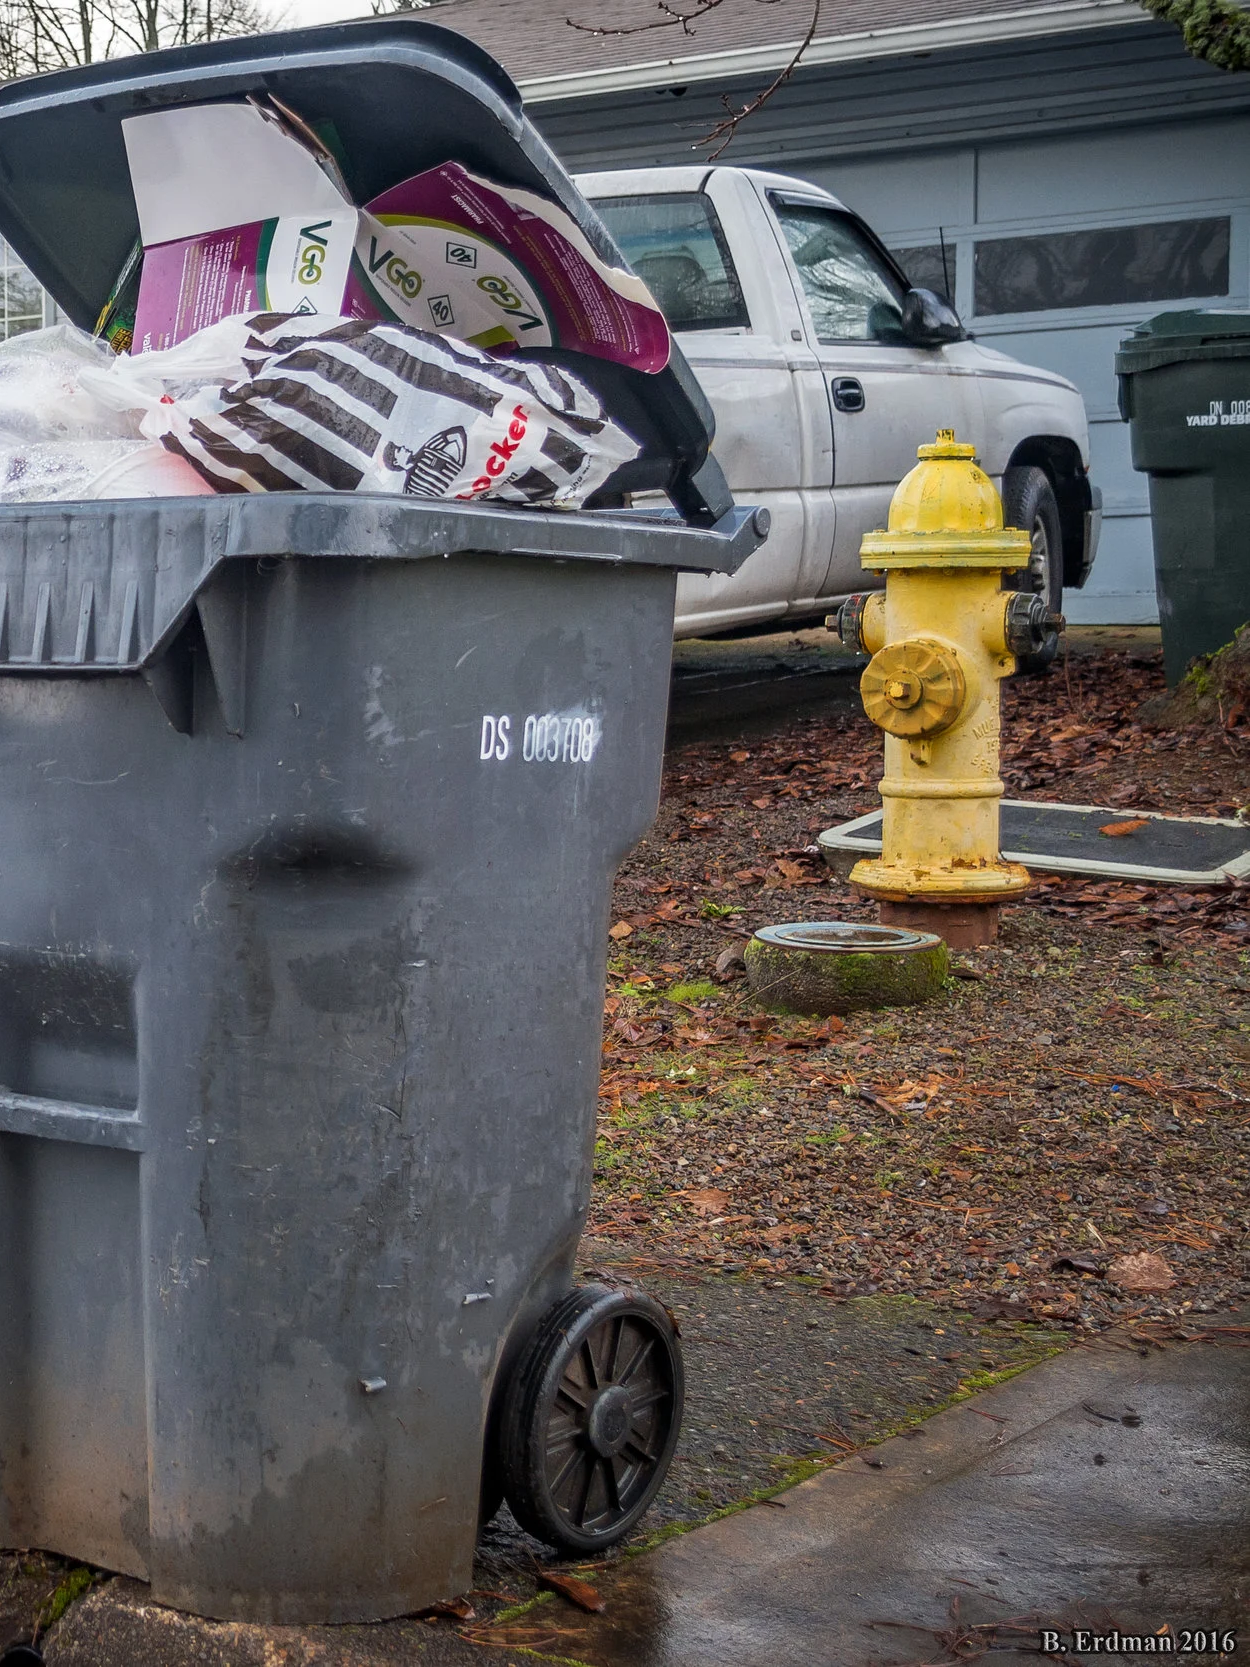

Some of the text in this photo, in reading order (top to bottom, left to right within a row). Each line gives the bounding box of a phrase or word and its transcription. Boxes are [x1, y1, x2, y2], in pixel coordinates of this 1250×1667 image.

[450, 247, 473, 263] 40
[432, 300, 449, 321] 40
[1186, 415, 1218, 427] YARD
[479, 715, 511, 761] DS
